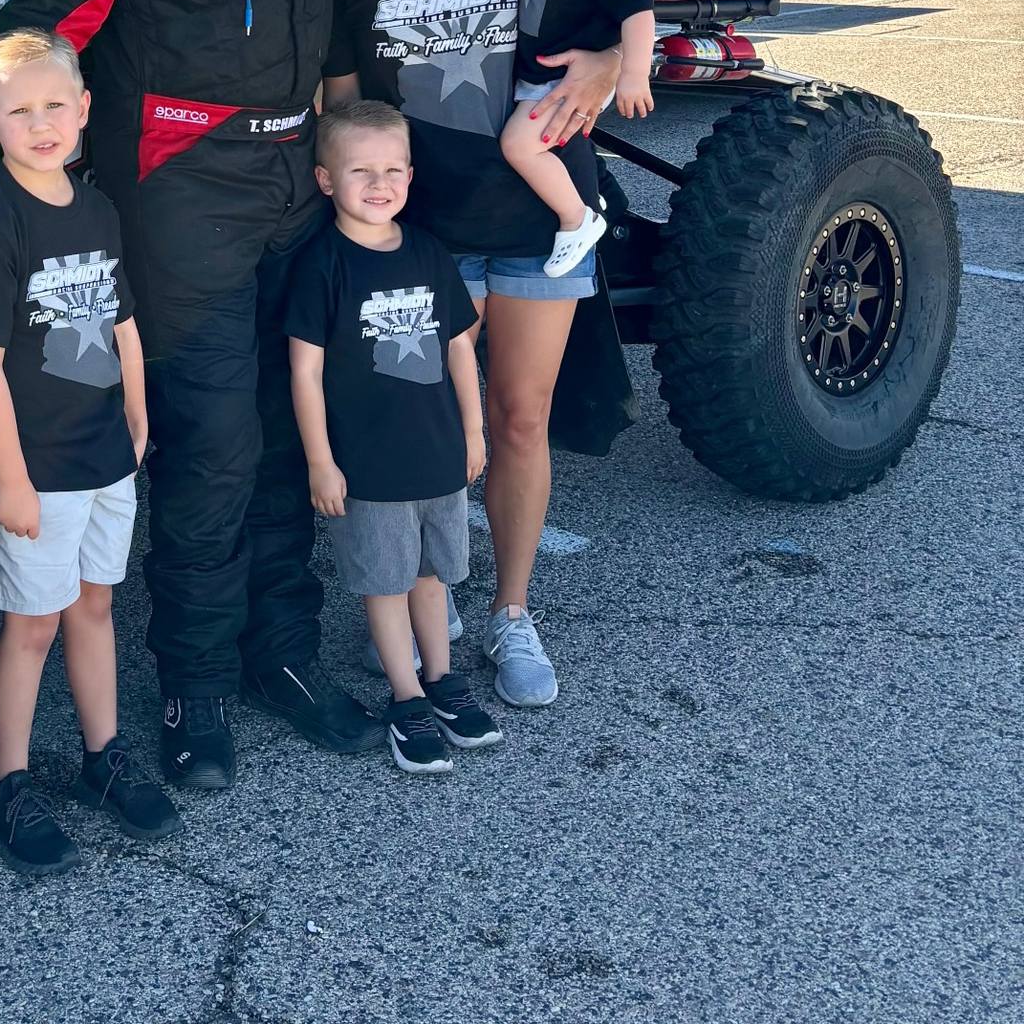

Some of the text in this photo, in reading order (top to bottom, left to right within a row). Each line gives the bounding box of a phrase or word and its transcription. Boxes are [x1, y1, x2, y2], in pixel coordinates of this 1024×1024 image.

[404, 2, 518, 24] RACING SUSPENSIO
[376, 26, 518, 58] Faith Family Freed
[154, 105, 209, 124] sparco
[249, 119, 260, 133] T.
[29, 311, 56, 326] Faith
